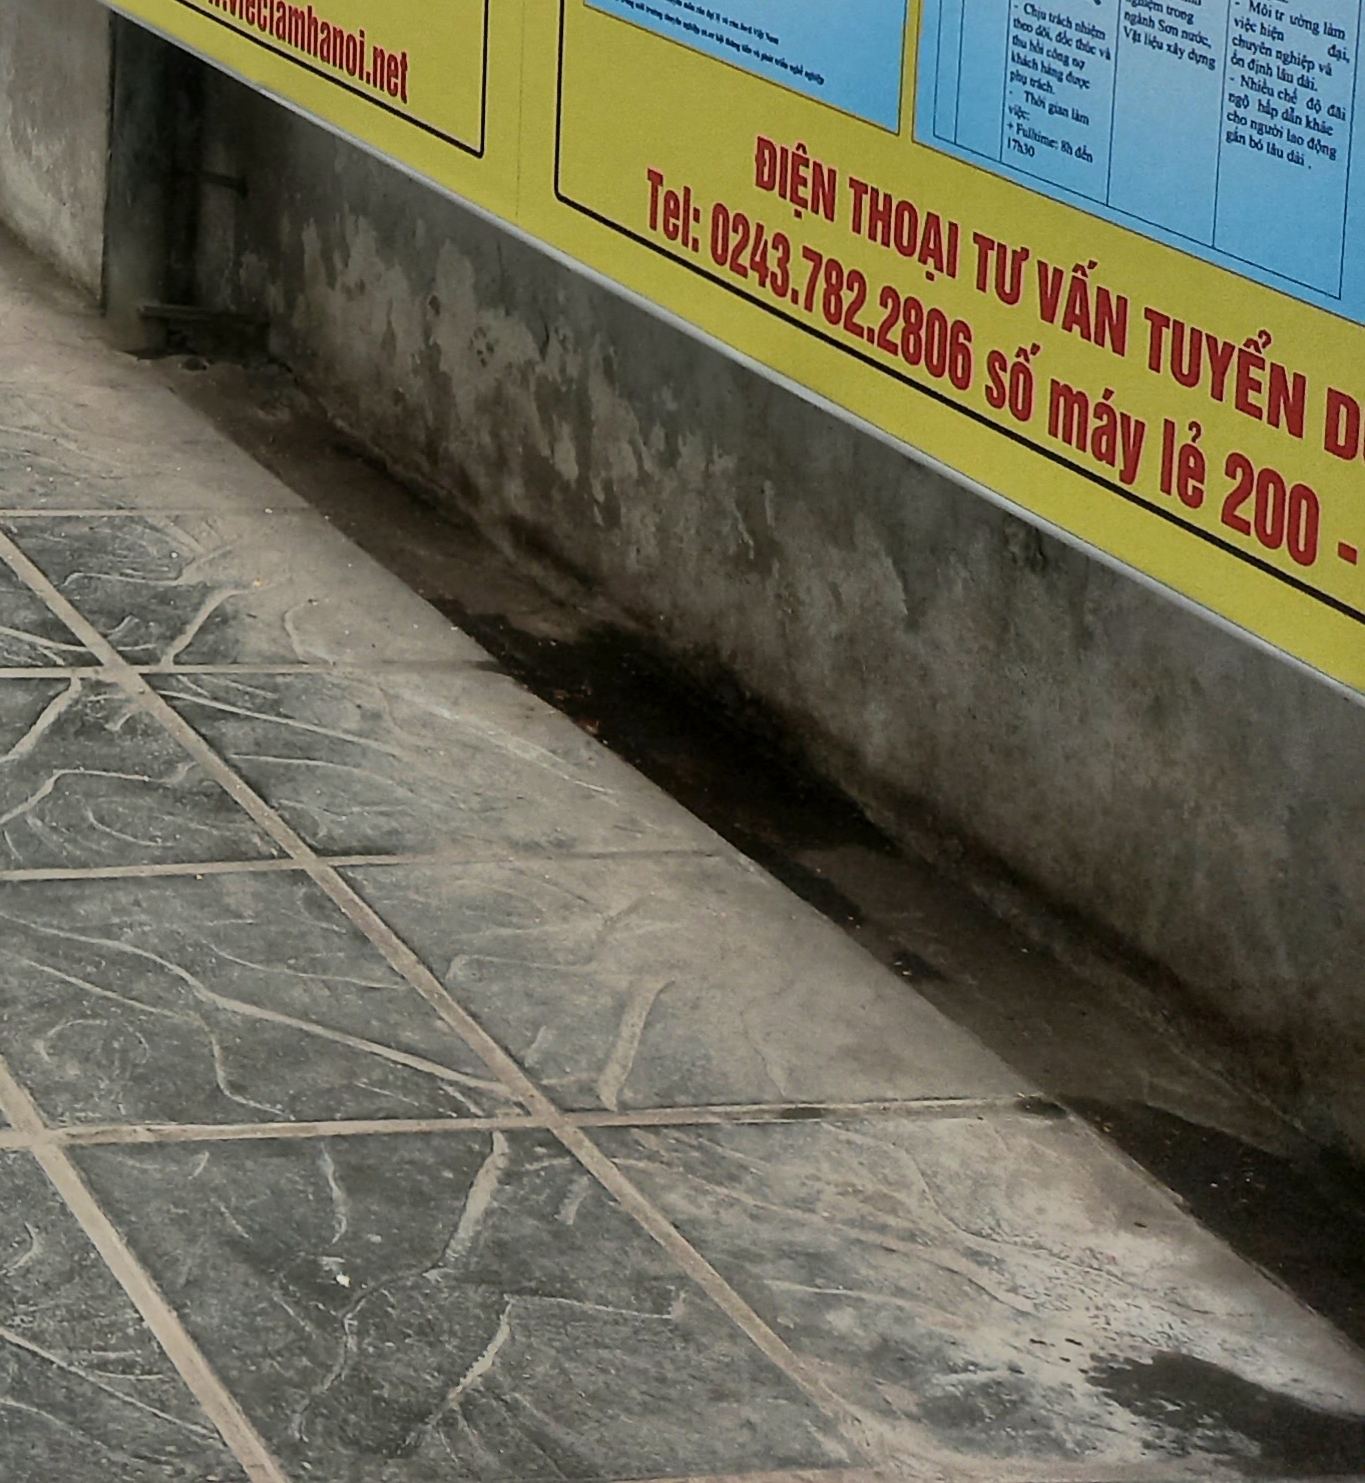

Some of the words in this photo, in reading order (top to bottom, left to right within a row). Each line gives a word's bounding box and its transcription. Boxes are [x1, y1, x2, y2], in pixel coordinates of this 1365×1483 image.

[647, 167, 700, 252] Tel:
[711, 202, 973, 391] 0243.782.2806
[985, 343, 1041, 422] số
[1048, 378, 1145, 486] máy
[1160, 418, 1206, 509] lẻ
[1221, 452, 1320, 567] 200
[755, 136, 837, 221] ĐIỆN
[849, 176, 959, 281] THOẠI
[972, 231, 1030, 305] TƯ
[1037, 261, 1128, 357] VẤN
[1144, 307, 1306, 439] TUYỂN
